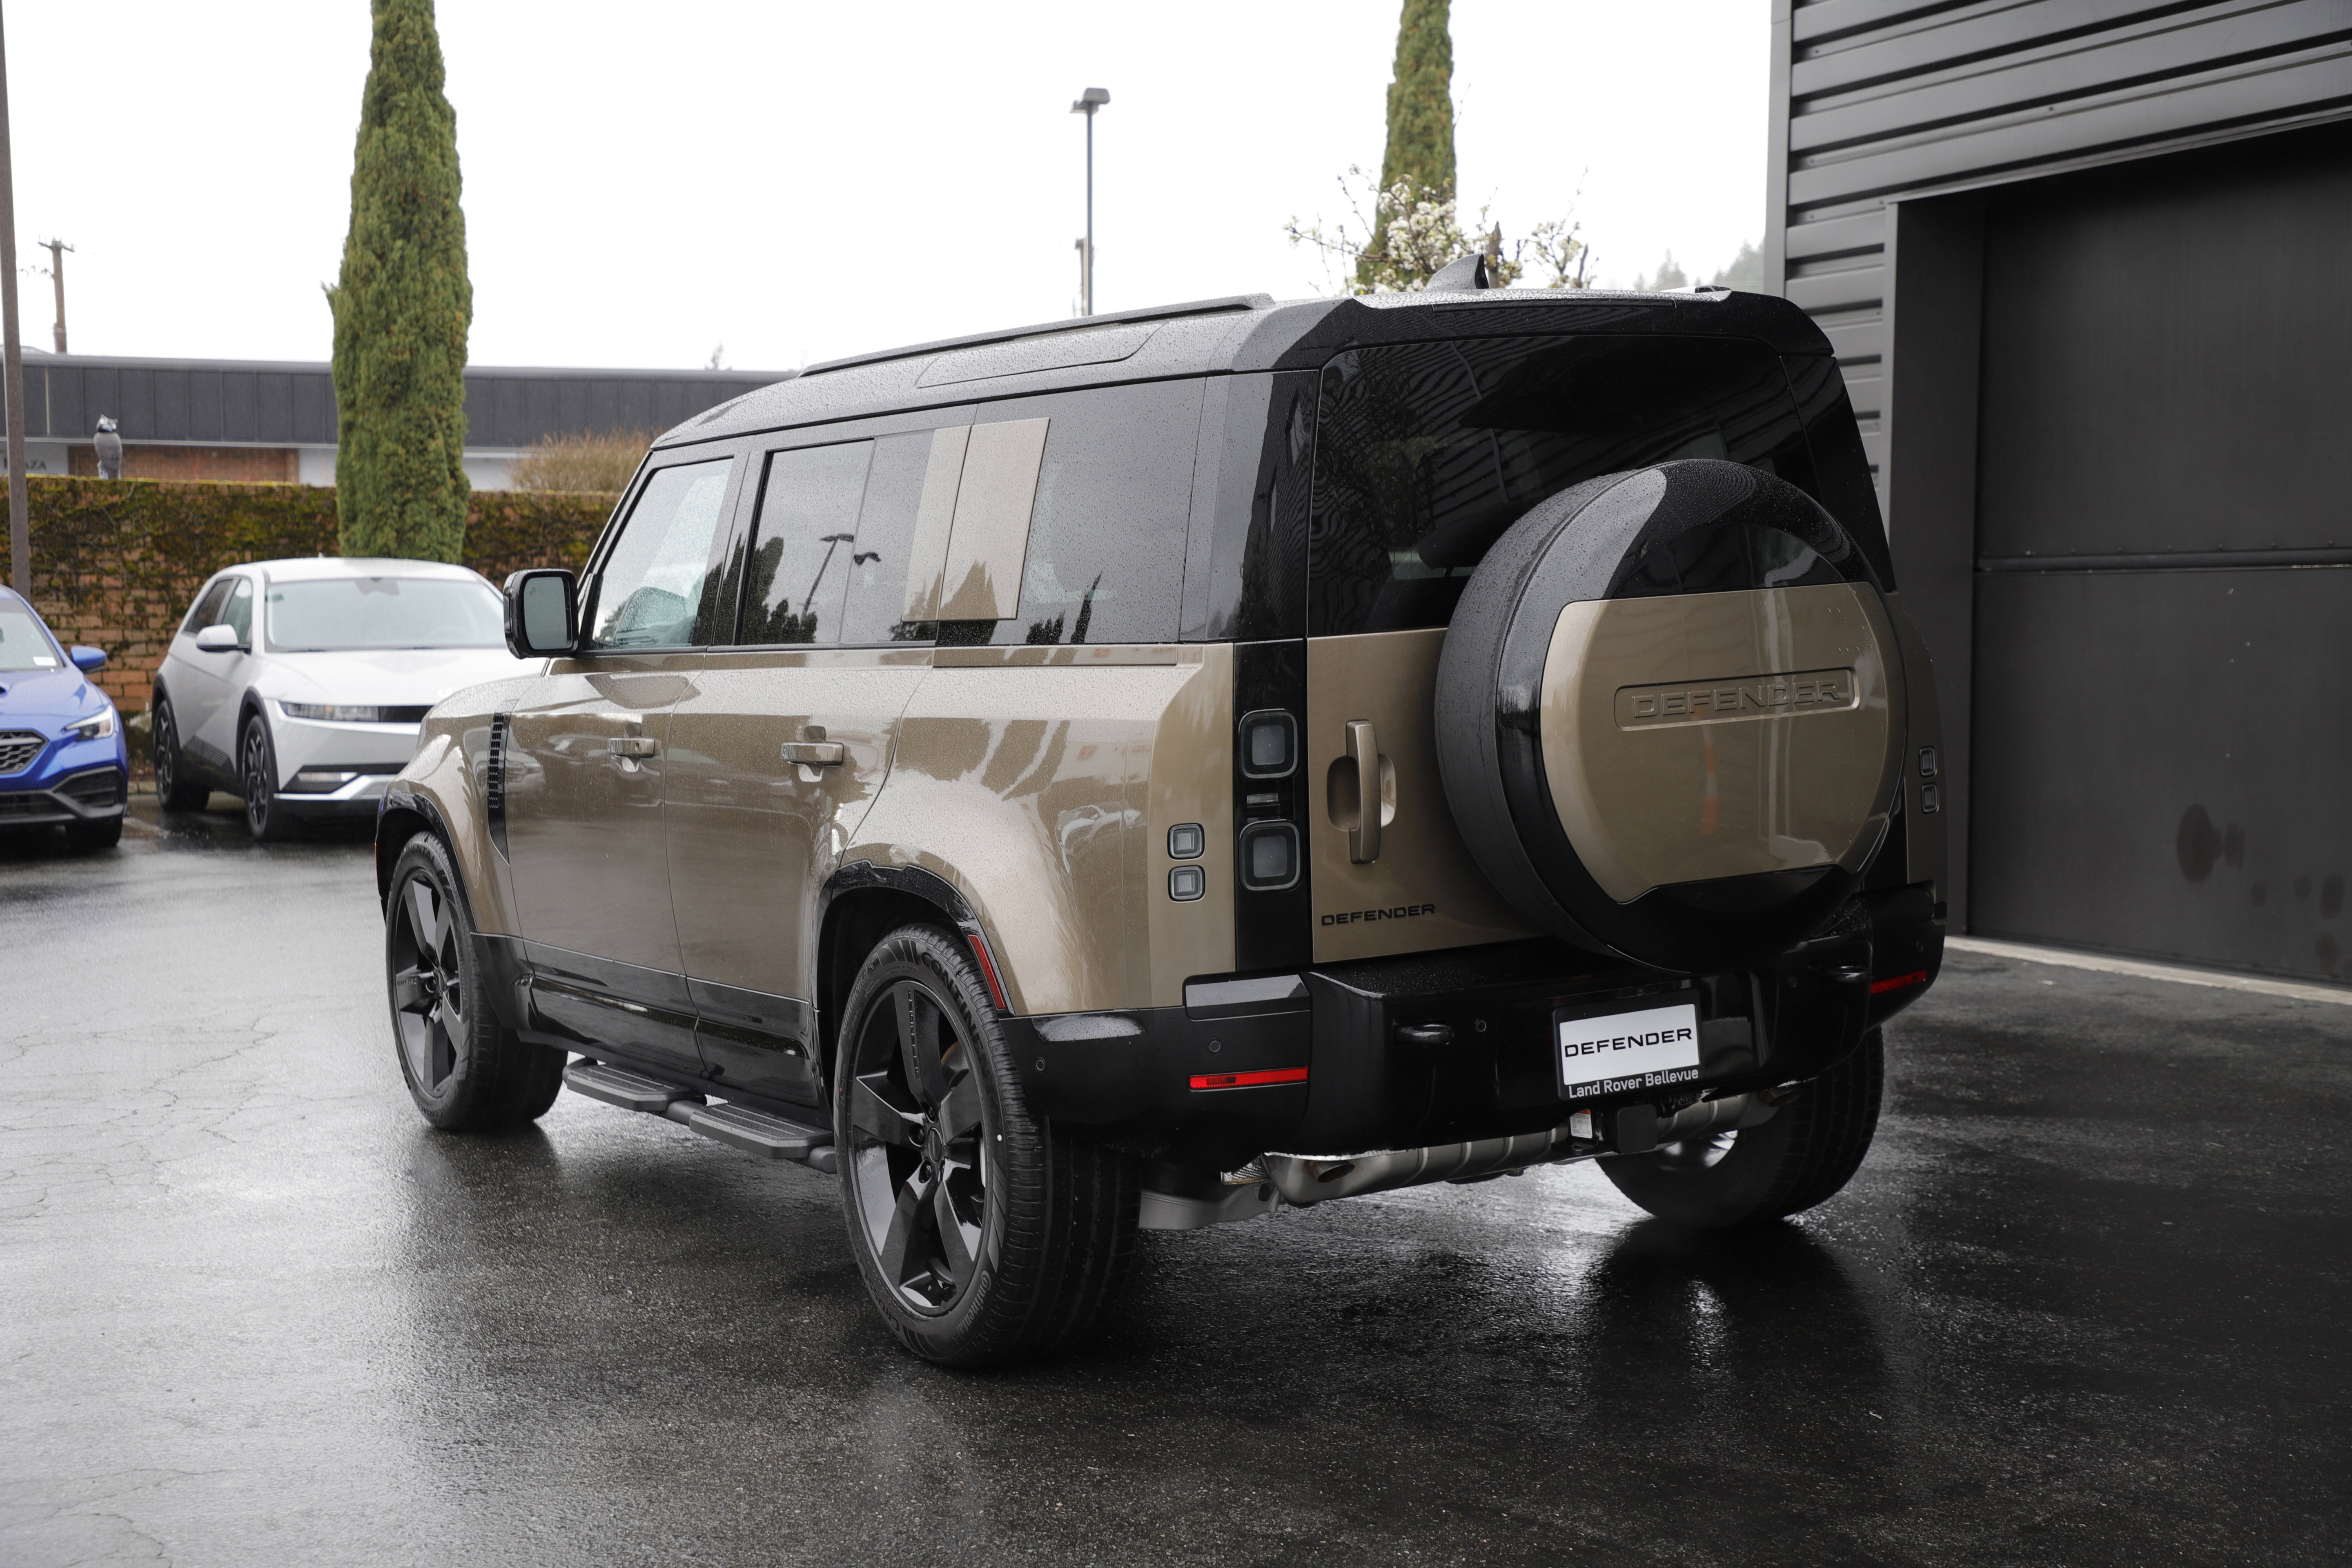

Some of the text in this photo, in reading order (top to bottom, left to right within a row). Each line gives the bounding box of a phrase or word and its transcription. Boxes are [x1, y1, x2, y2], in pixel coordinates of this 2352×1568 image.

[1632, 680, 1840, 718] DEFENDER
[1321, 904, 1435, 926] DEFENDER
[1564, 1028, 1692, 1057] DEFENDER
[1568, 1069, 1699, 1098] Land Rover Bellevue
[956, 1270, 992, 1340] Continental
